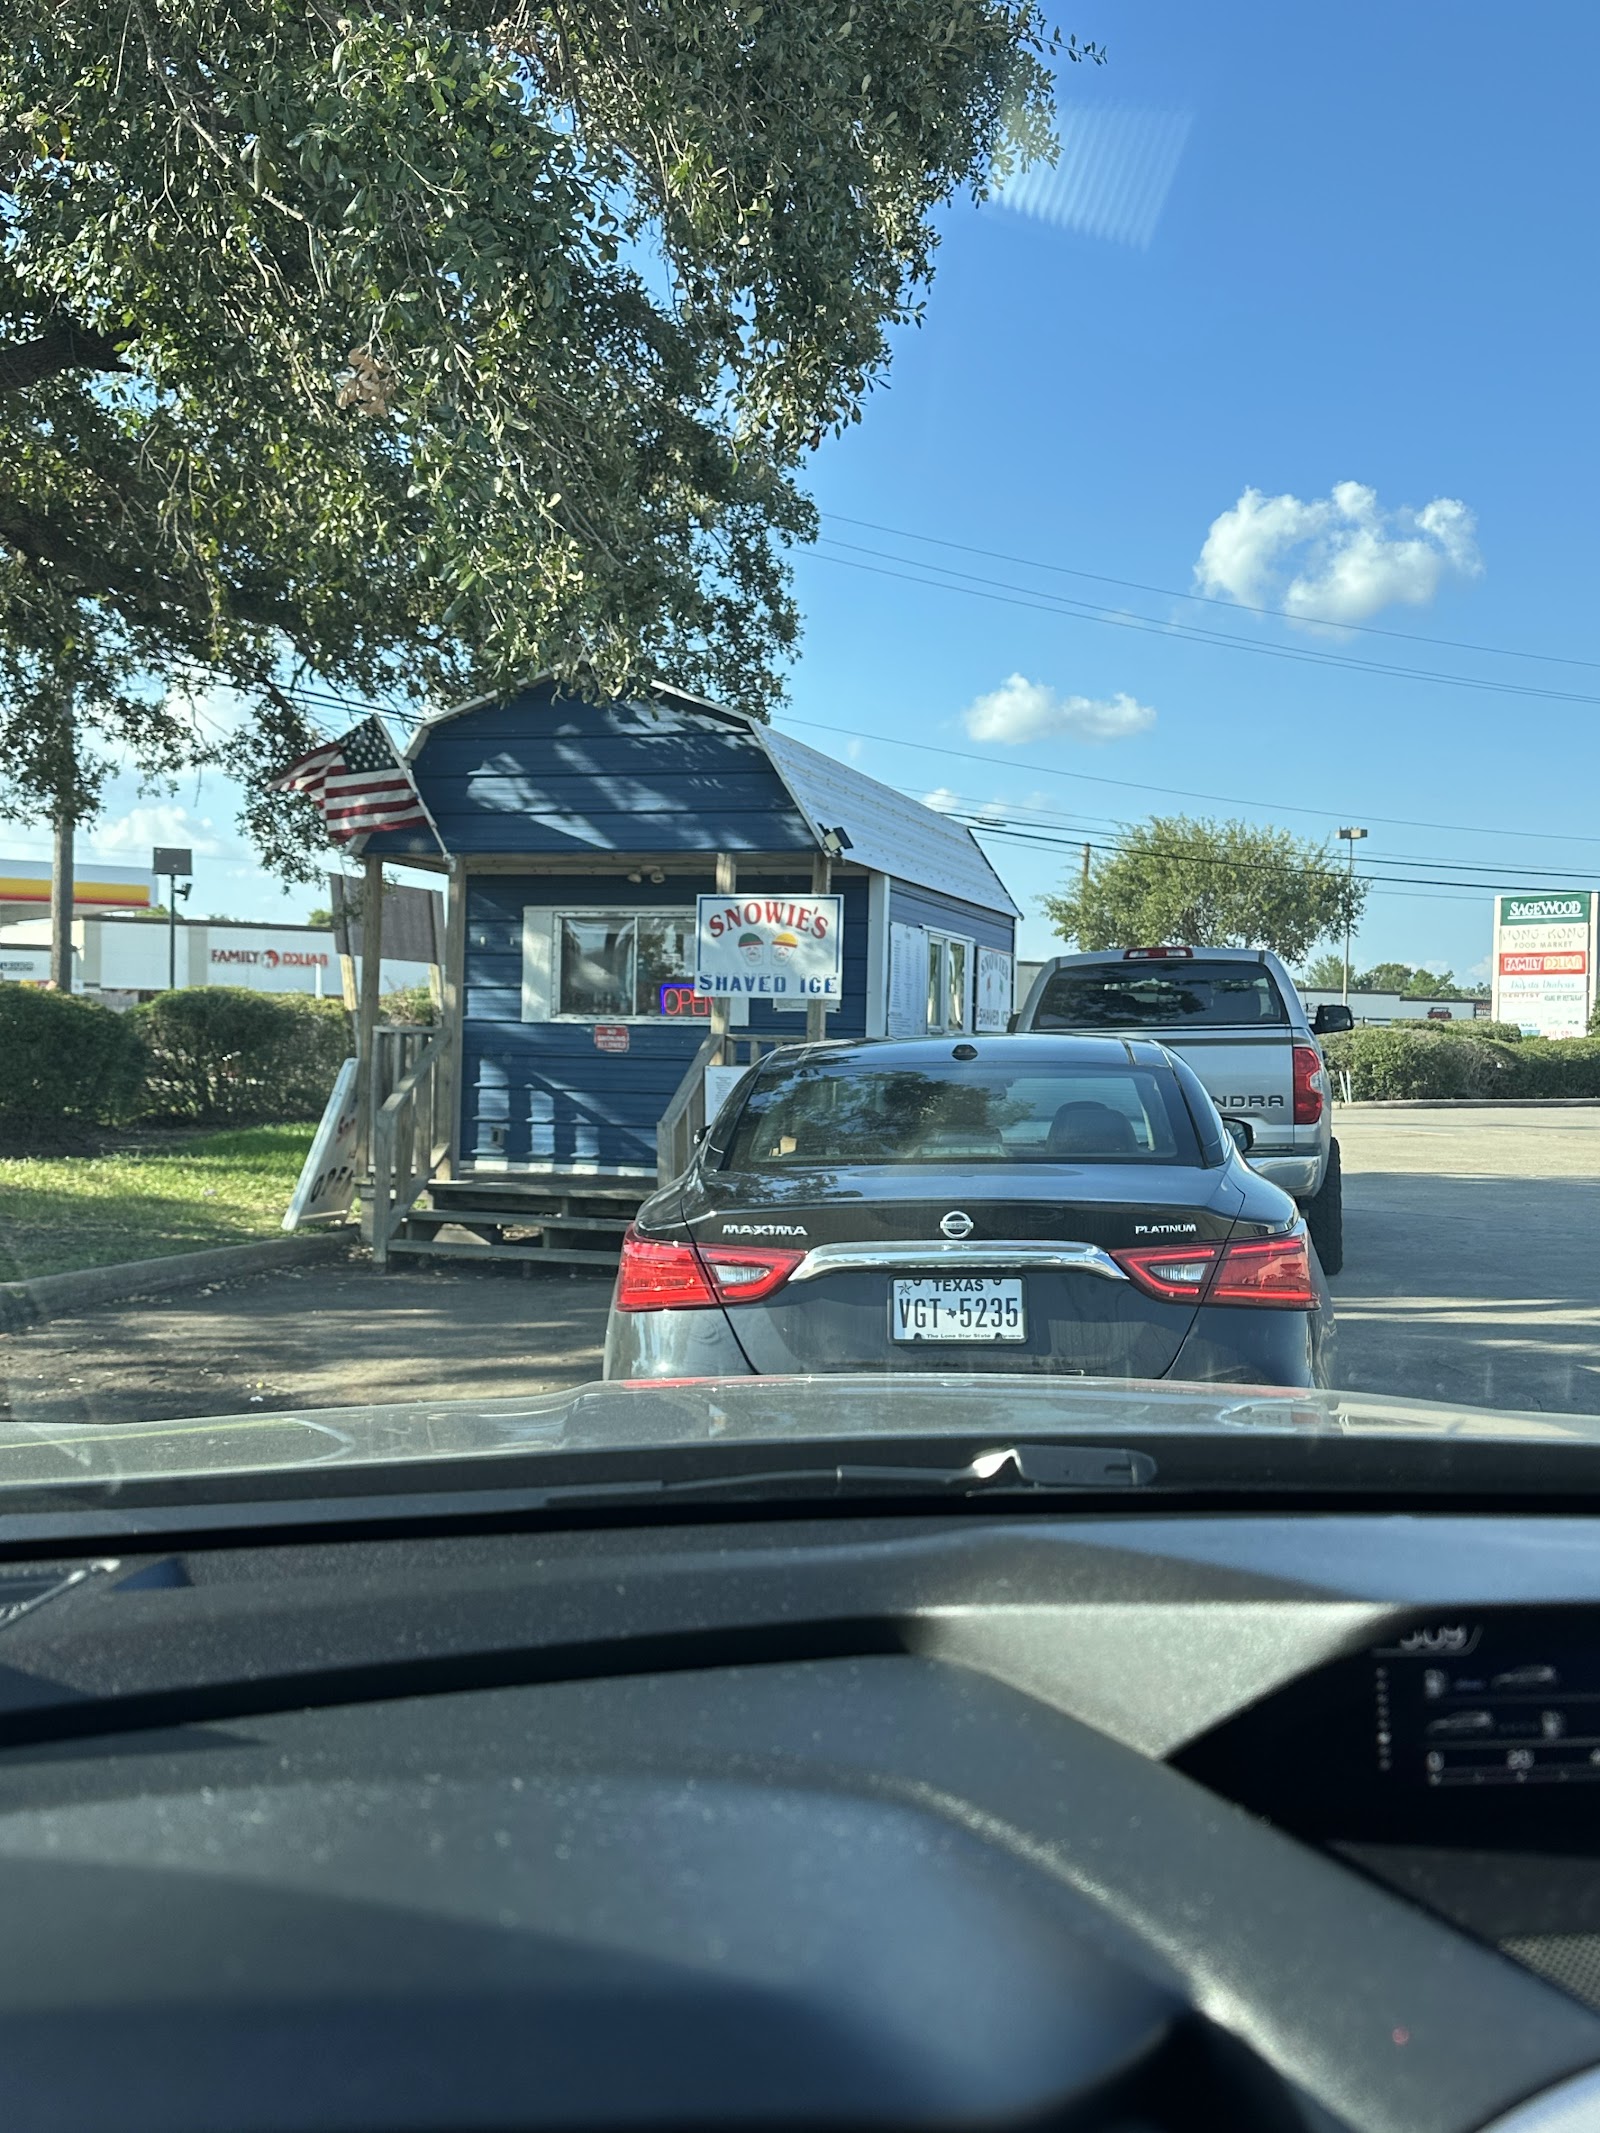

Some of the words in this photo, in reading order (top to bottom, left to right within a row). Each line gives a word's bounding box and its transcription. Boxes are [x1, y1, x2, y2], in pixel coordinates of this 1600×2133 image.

[1509, 900, 1581, 916] SAGEWOOD
[708, 900, 829, 939] SNOWIE'S
[1539, 940, 1573, 948] MARKET
[211, 949, 259, 964] FAMILY
[1504, 957, 1542, 971] FAMILY
[699, 972, 787, 993] SHAVED
[800, 973, 838, 994] ICE
[1210, 1094, 1285, 1109] NDRA
[721, 1224, 809, 1236] MAXIMA
[1135, 1223, 1197, 1235] PLATINUM
[932, 1279, 984, 1292] TEXAS
[899, 1298, 942, 1329] VGT
[959, 1297, 1018, 1329] 5235
